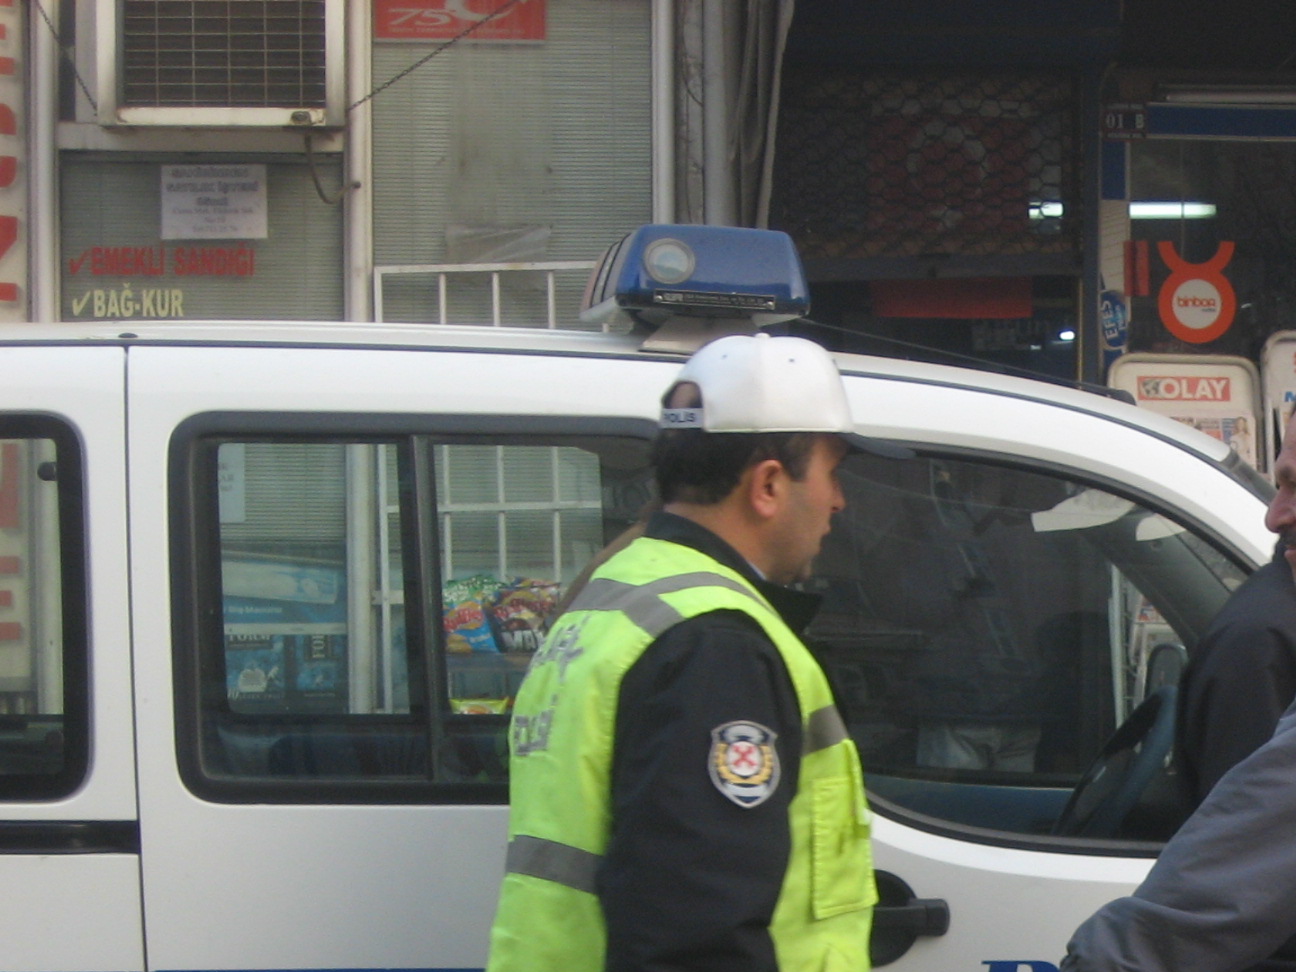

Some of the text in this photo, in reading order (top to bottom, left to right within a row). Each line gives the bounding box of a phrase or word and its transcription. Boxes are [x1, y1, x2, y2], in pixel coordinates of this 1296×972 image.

[93, 283, 184, 317] BAĞ-KUR
[1100, 300, 1119, 339] EFES
[1159, 379, 1229, 400] OLAY
